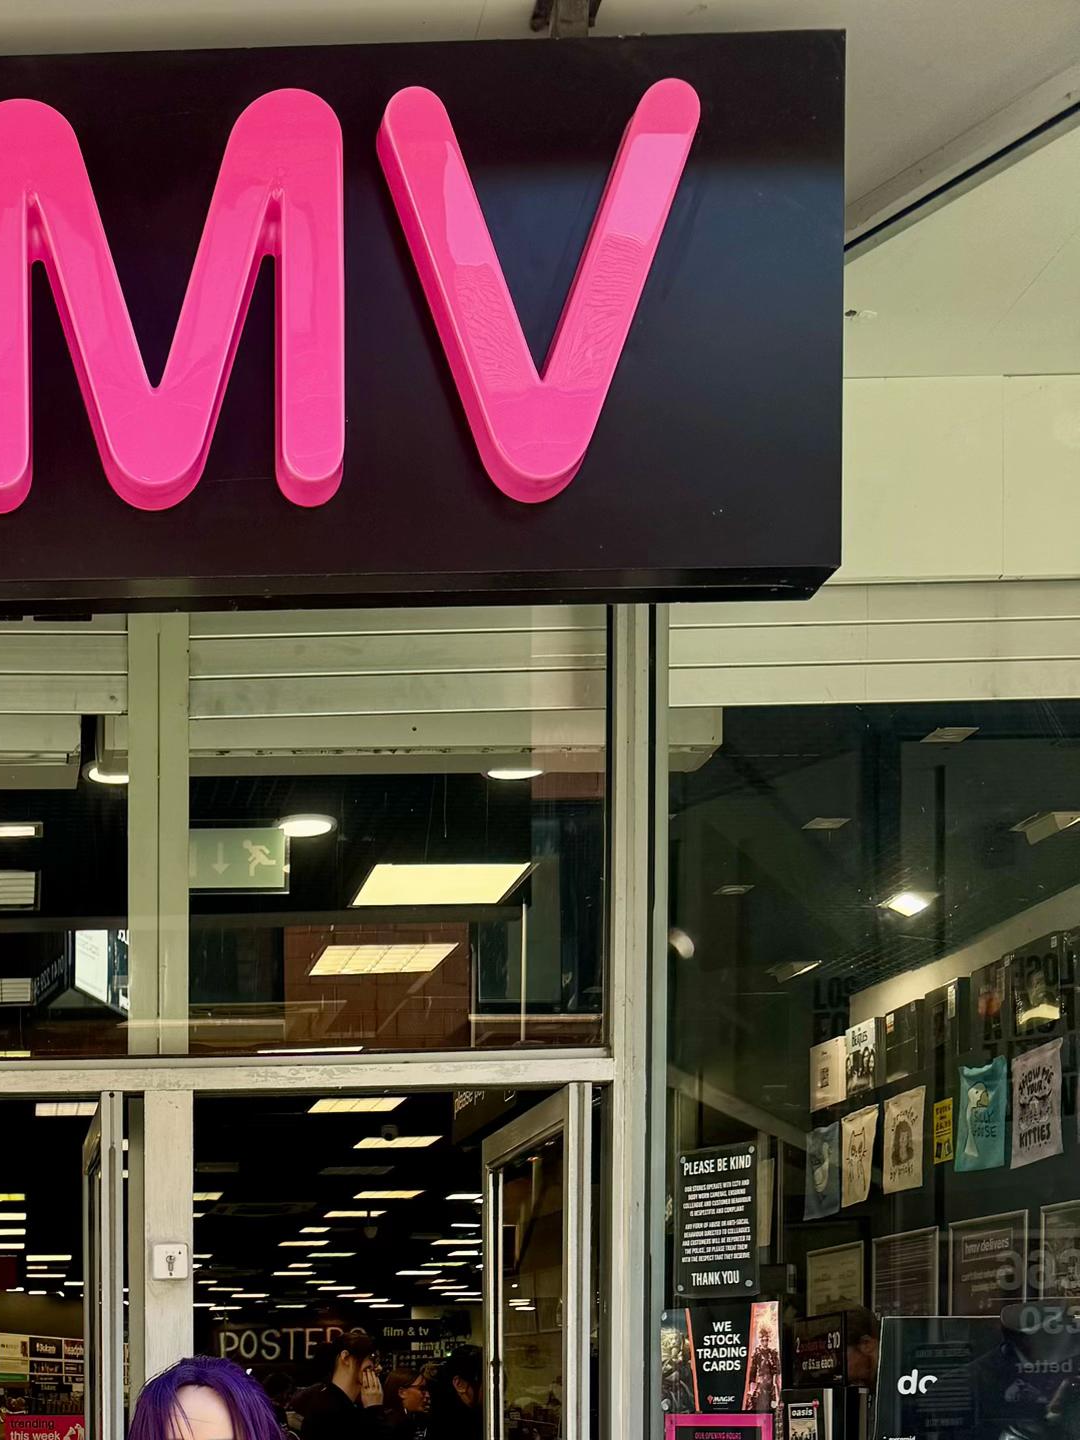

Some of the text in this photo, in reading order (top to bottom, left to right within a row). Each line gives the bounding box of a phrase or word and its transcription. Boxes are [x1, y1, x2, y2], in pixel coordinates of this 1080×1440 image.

[684, 1155, 751, 1176] PLEASE BE KIND
[691, 1270, 739, 1286] THANK YOU
[383, 1326, 430, 1337] film & tv
[713, 1321, 732, 1332] WE
[220, 1326, 367, 1360] POSTE
[703, 1334, 740, 1345] STOCK
[696, 1347, 747, 1359] TRADING
[703, 1360, 741, 1371] CARDS
[792, 1408, 813, 1416] oasis
[10, 1419, 55, 1431] trending
[10, 1431, 61, 1440] this week
